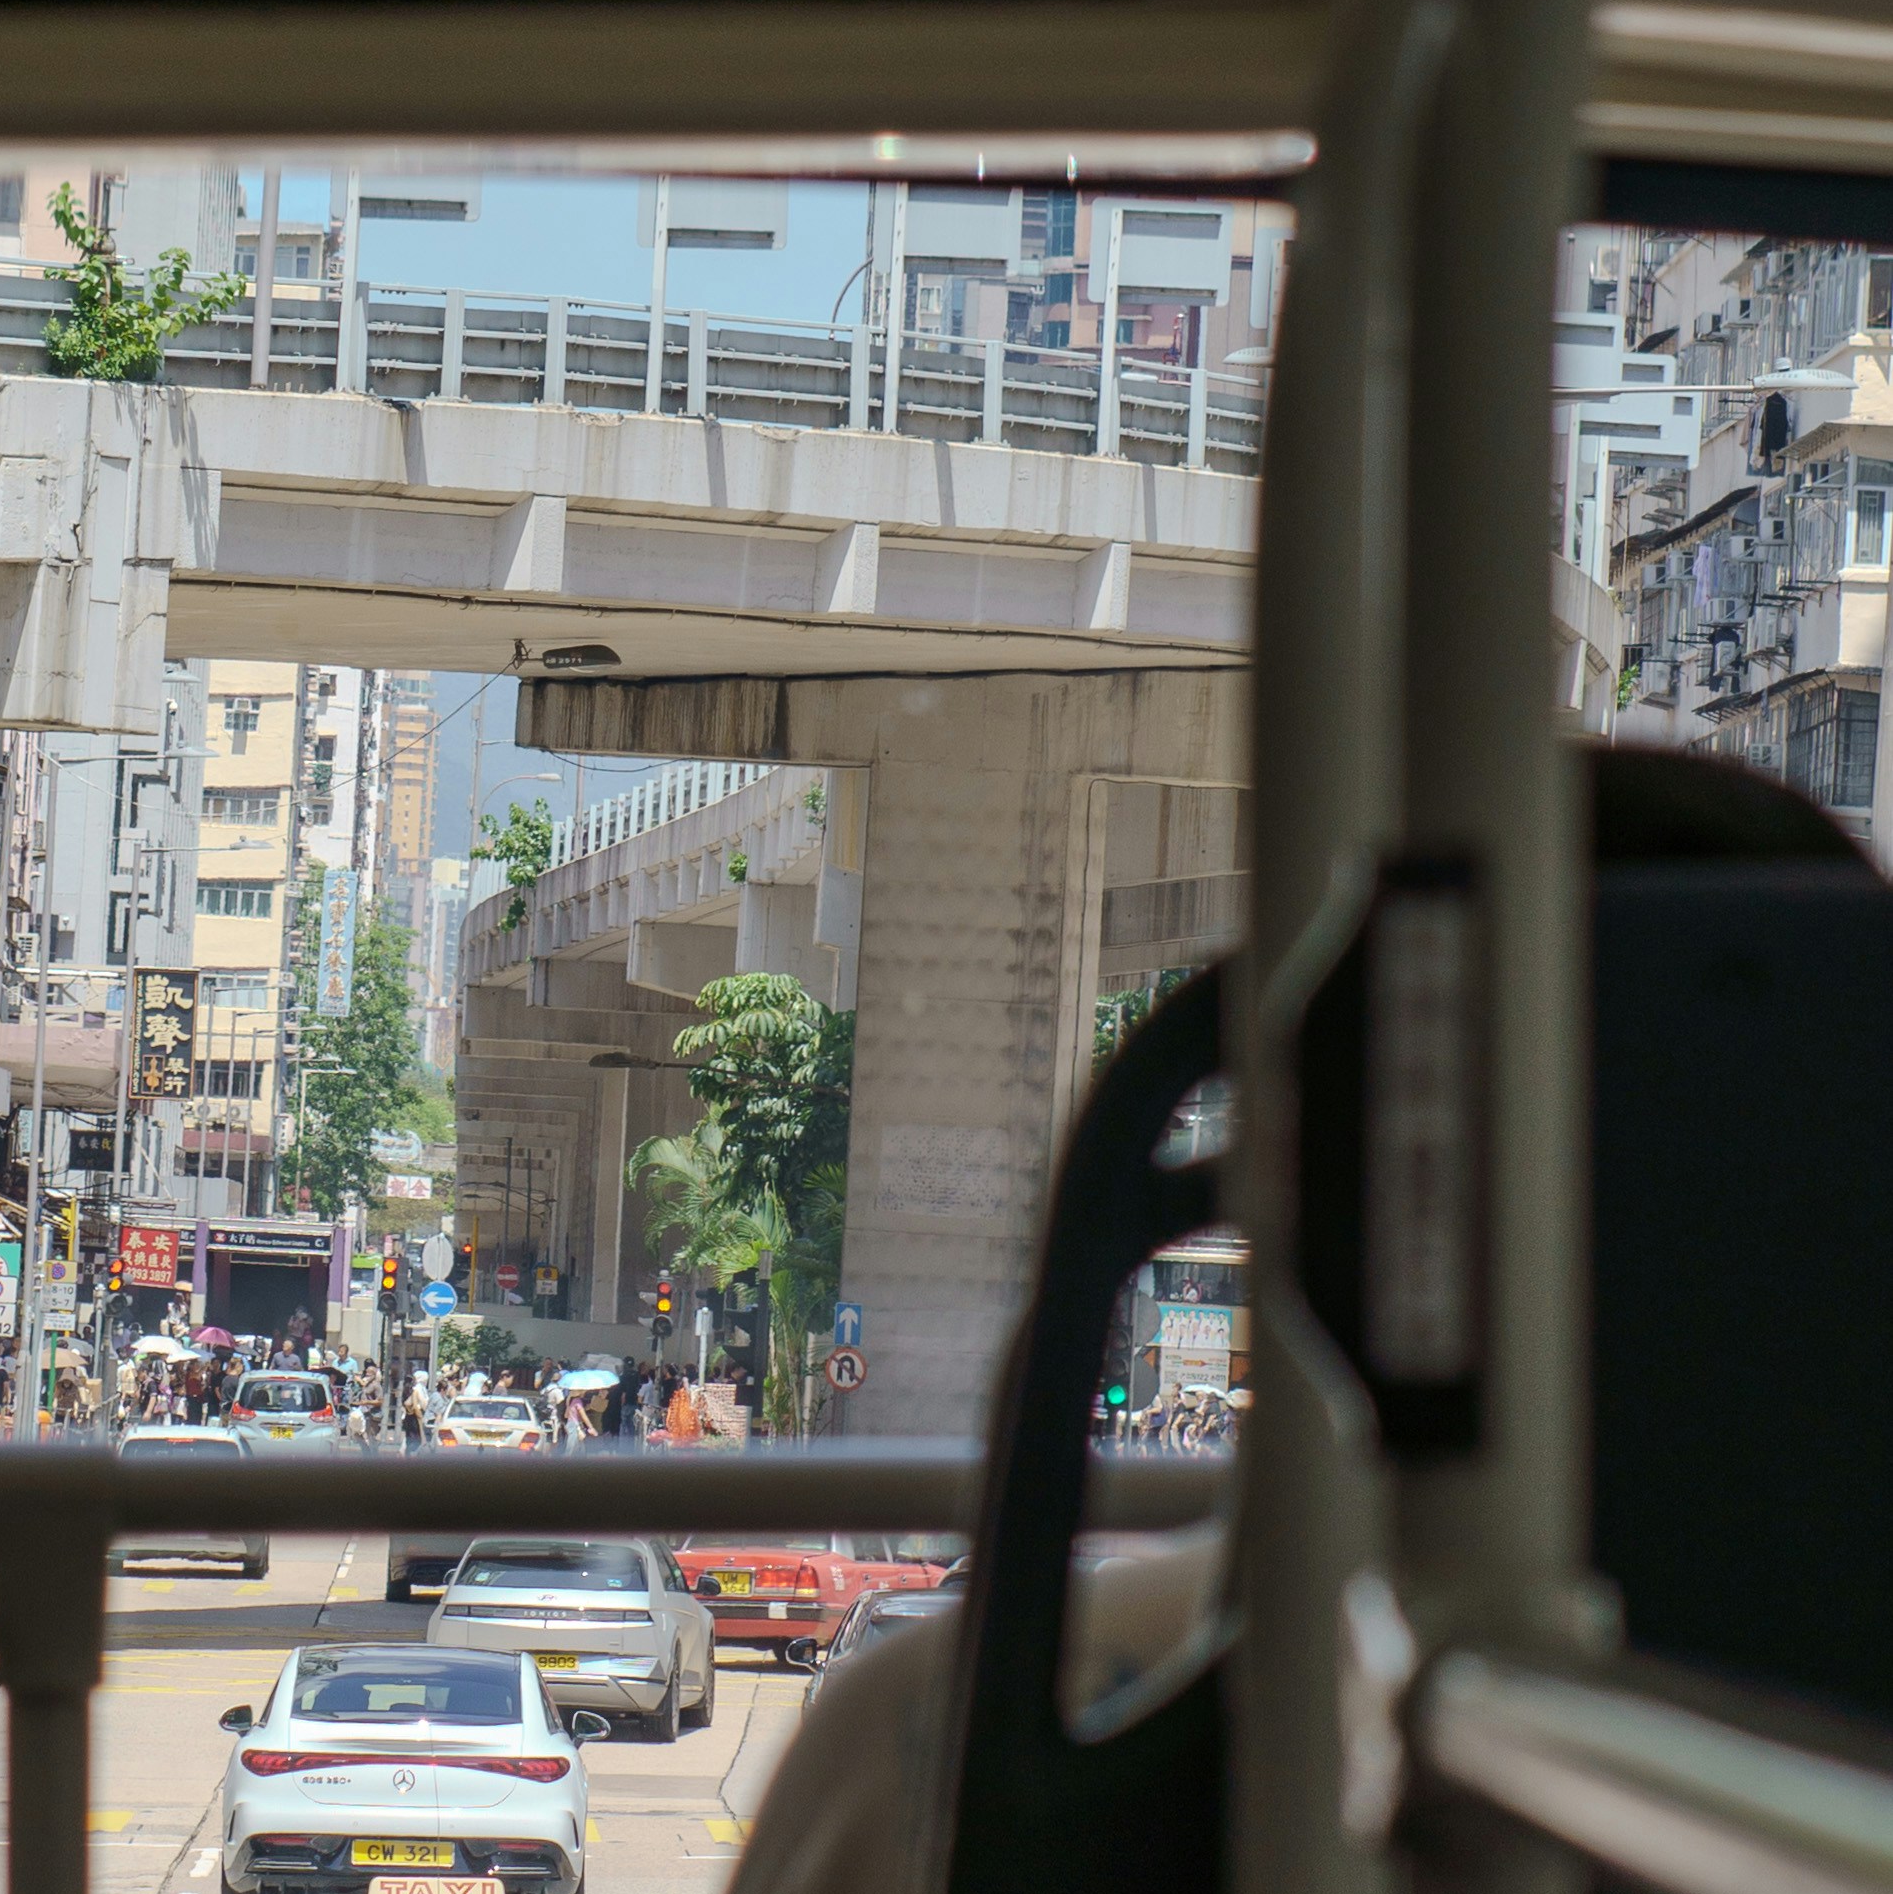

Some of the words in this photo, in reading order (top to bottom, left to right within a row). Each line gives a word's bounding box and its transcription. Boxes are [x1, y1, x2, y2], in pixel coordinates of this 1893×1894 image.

[143, 973, 194, 1055] 凱聲
[125, 1230, 173, 1253] 泰安
[718, 1582, 747, 1595] 364
[367, 1845, 395, 1861] CW
[405, 1845, 438, 1863] 321
